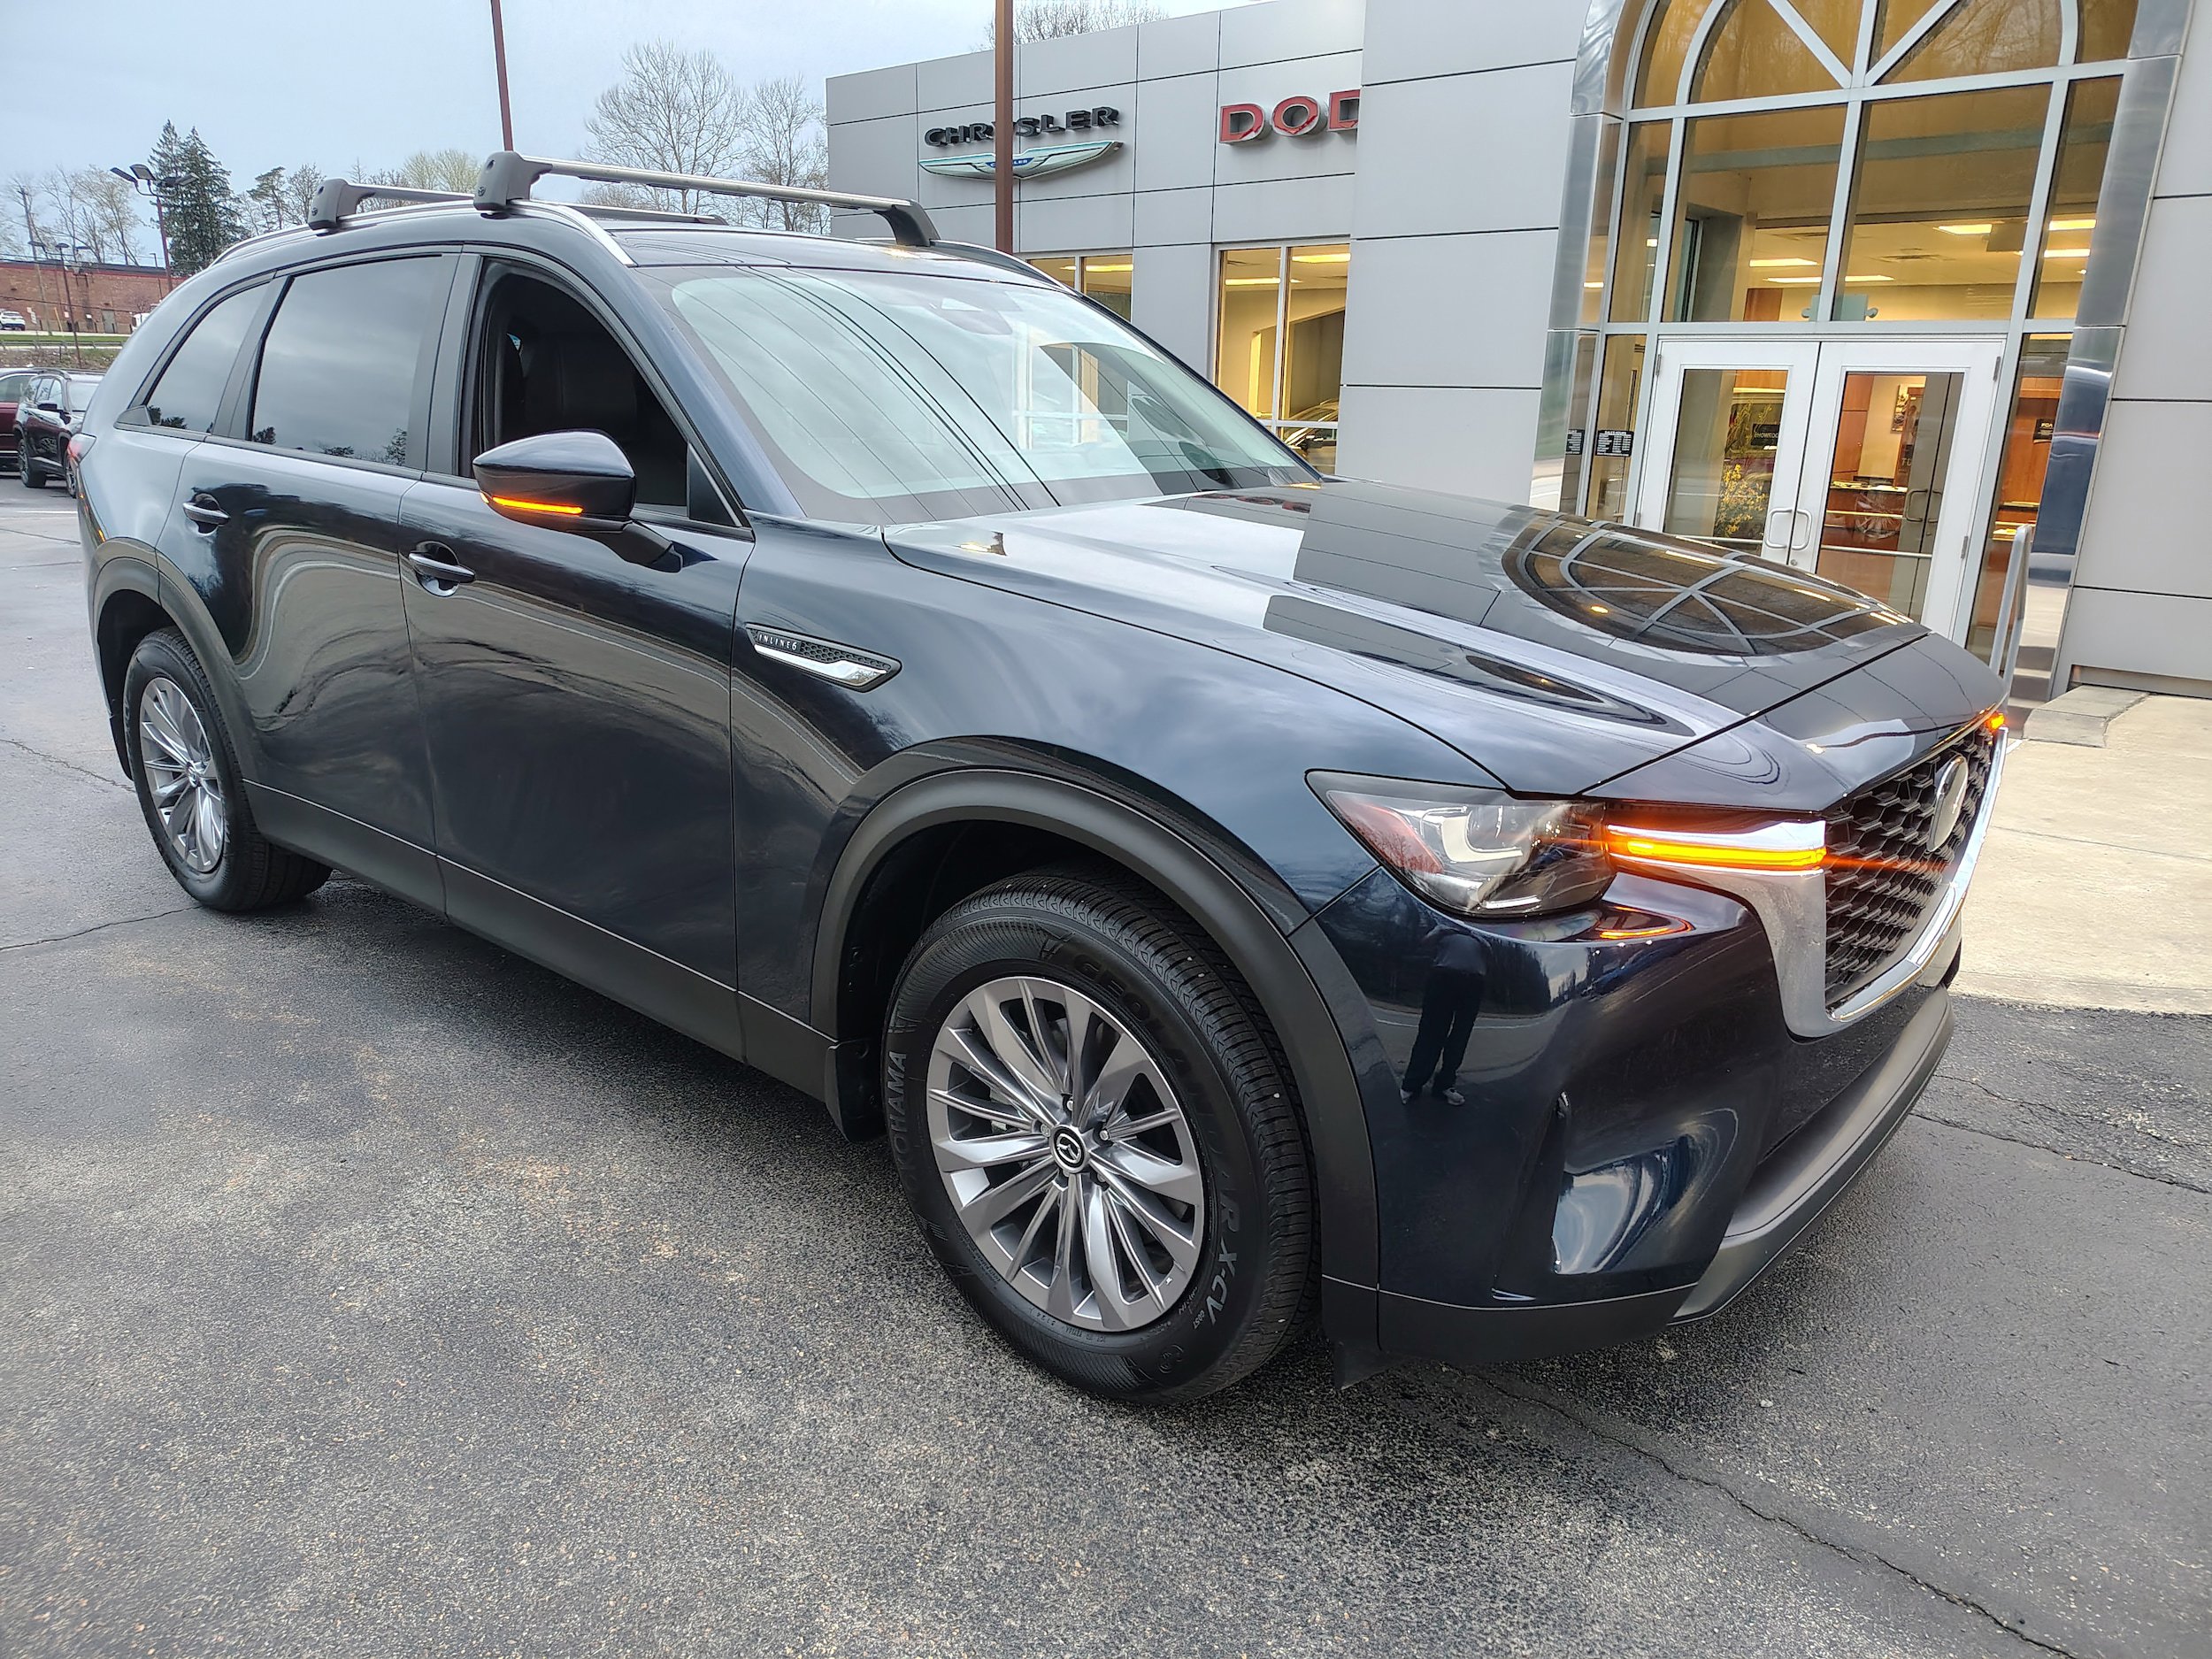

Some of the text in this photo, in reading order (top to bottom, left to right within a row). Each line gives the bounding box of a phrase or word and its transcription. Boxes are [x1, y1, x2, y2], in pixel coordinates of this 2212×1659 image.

[925, 106, 1119, 147] CHRSLER
[1219, 88, 1361, 143] DOD
[887, 1051, 920, 1202] OKOHAMA
